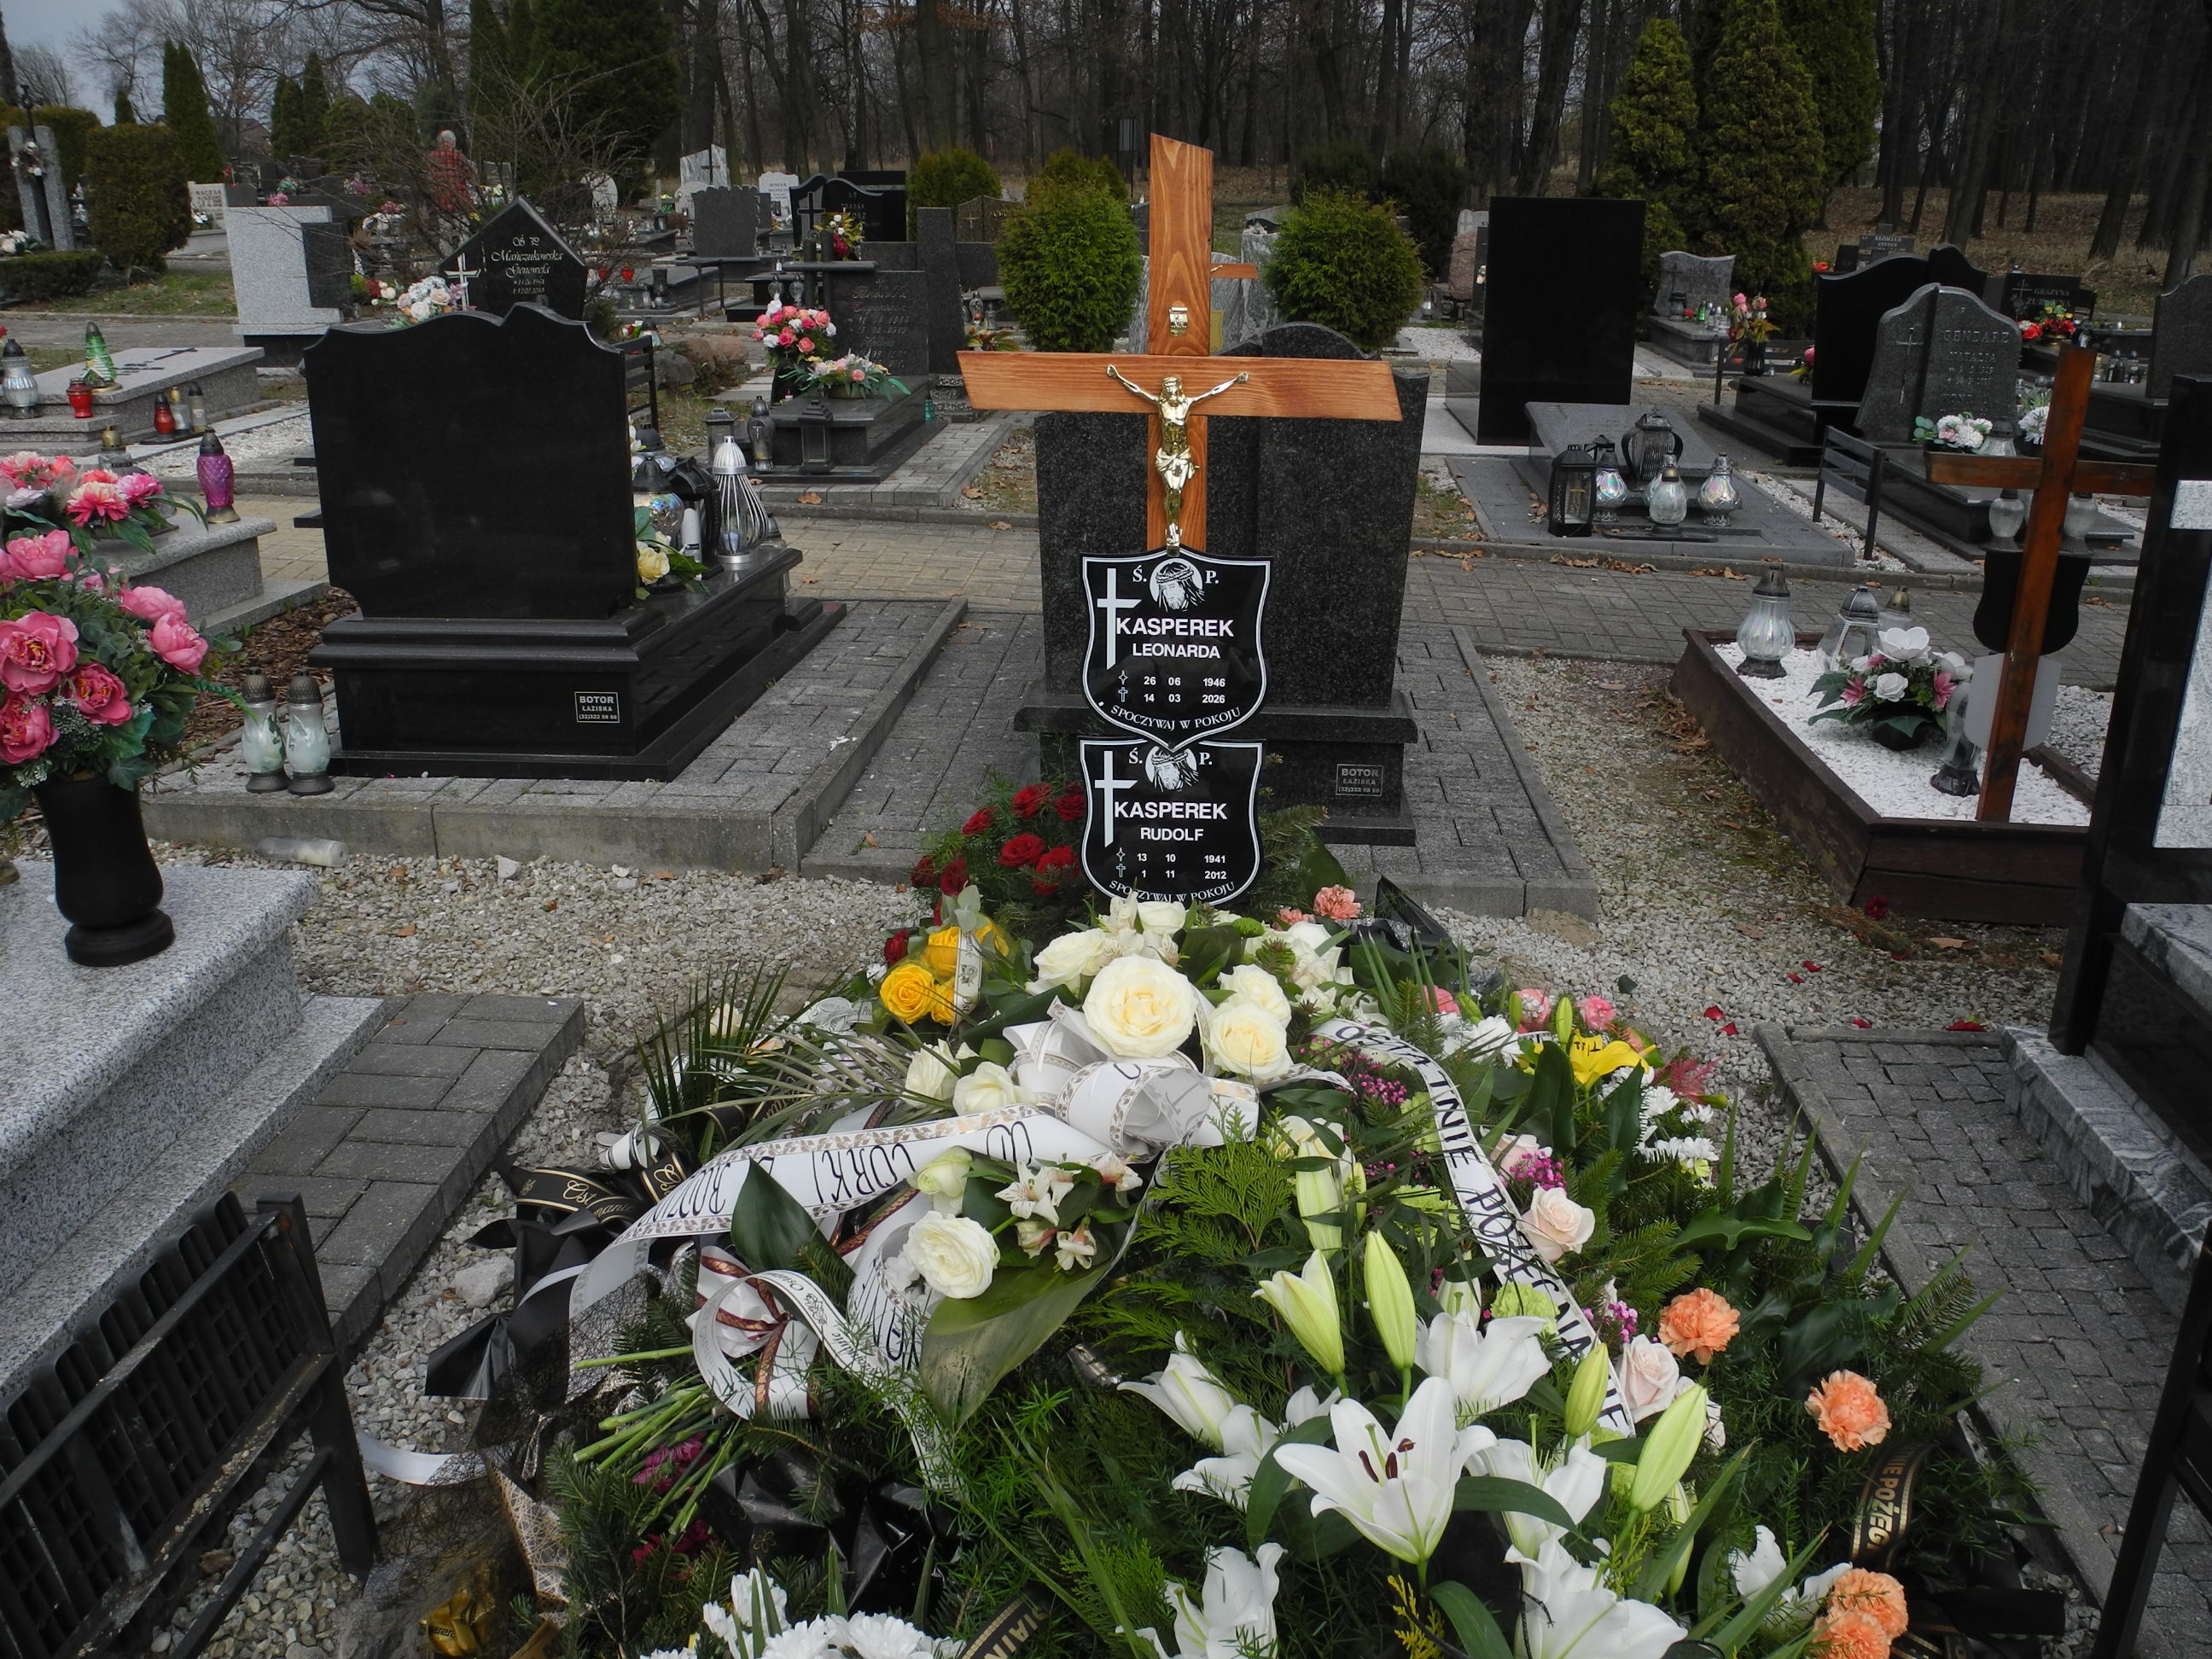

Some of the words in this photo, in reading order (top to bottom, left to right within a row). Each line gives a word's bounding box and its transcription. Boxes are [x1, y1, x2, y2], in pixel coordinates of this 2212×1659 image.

[1132, 564, 1148, 583] Ś.
[1205, 569, 1220, 585] P.
[1116, 616, 1235, 637] KASPEREK
[1132, 643, 1221, 659] LEONARDA
[1144, 676, 1156, 686] 26
[1167, 676, 1181, 686] 06
[1202, 677, 1226, 688] 1946
[579, 696, 614, 704] BOTOR
[1144, 693, 1155, 703] 14
[1167, 693, 1181, 703] 03
[1202, 694, 1226, 704] 2026
[1110, 704, 1175, 732] SPOCZYWAJ
[1179, 719, 1191, 730] W
[1194, 707, 1242, 729] POKOJU
[1128, 747, 1143, 765] Ś.
[1199, 752, 1213, 765] P.
[1342, 768, 1379, 777] BOTOR
[1114, 800, 1228, 820] KASPEREK
[1140, 826, 1204, 841] RUDOLF
[1137, 853, 1148, 862] 13
[1165, 853, 1177, 863] 10
[1203, 854, 1226, 864] 1941
[1141, 870, 1146, 878] 1
[1165, 870, 1175, 878] 11
[1204, 870, 1227, 880] 2012
[1109, 880, 1173, 903] SPOZYWAJ
[1175, 893, 1187, 903] W
[1190, 882, 1236, 900] POKOJU
[1335, 1025, 1483, 1170] OSTATNIE
